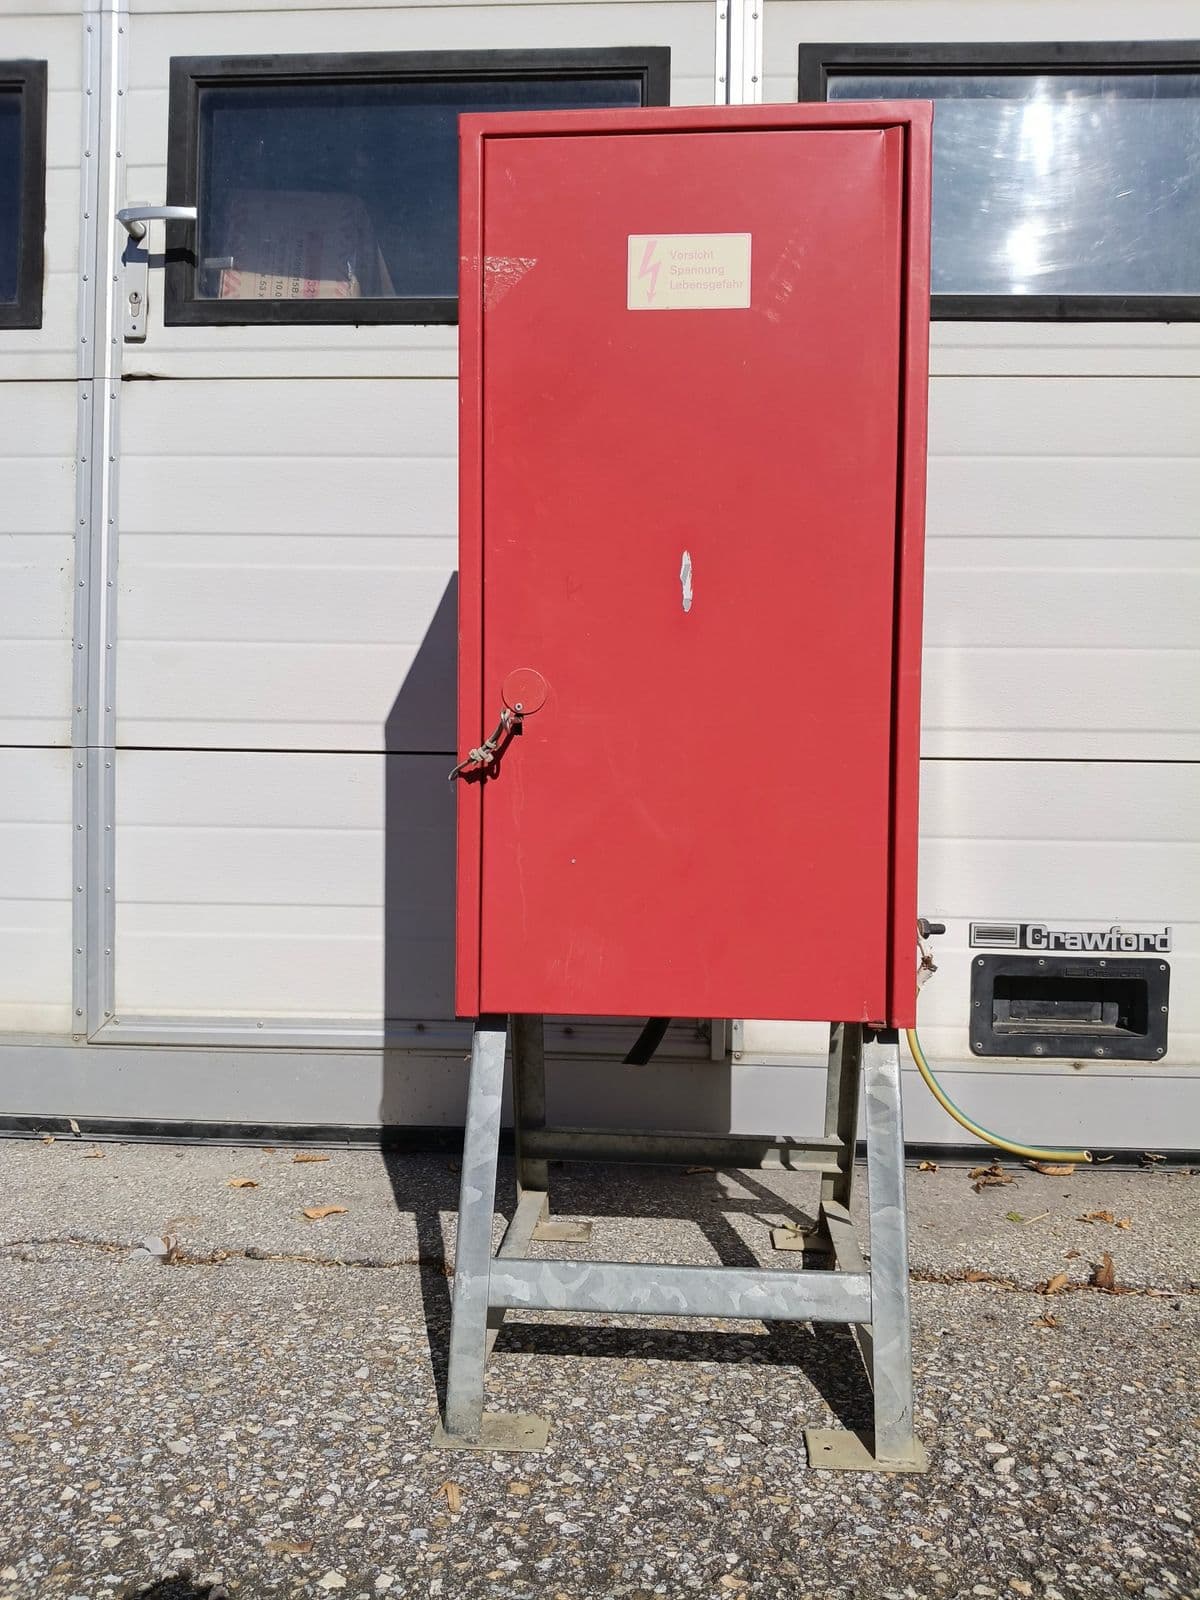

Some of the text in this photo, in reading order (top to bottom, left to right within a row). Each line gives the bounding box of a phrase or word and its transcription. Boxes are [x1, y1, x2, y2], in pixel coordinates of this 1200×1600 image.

[670, 250, 714, 260] Vorsicht
[670, 265, 725, 276] Spannung
[670, 279, 744, 291] Lebensgefahr
[1025, 923, 1172, 952] Crawford
